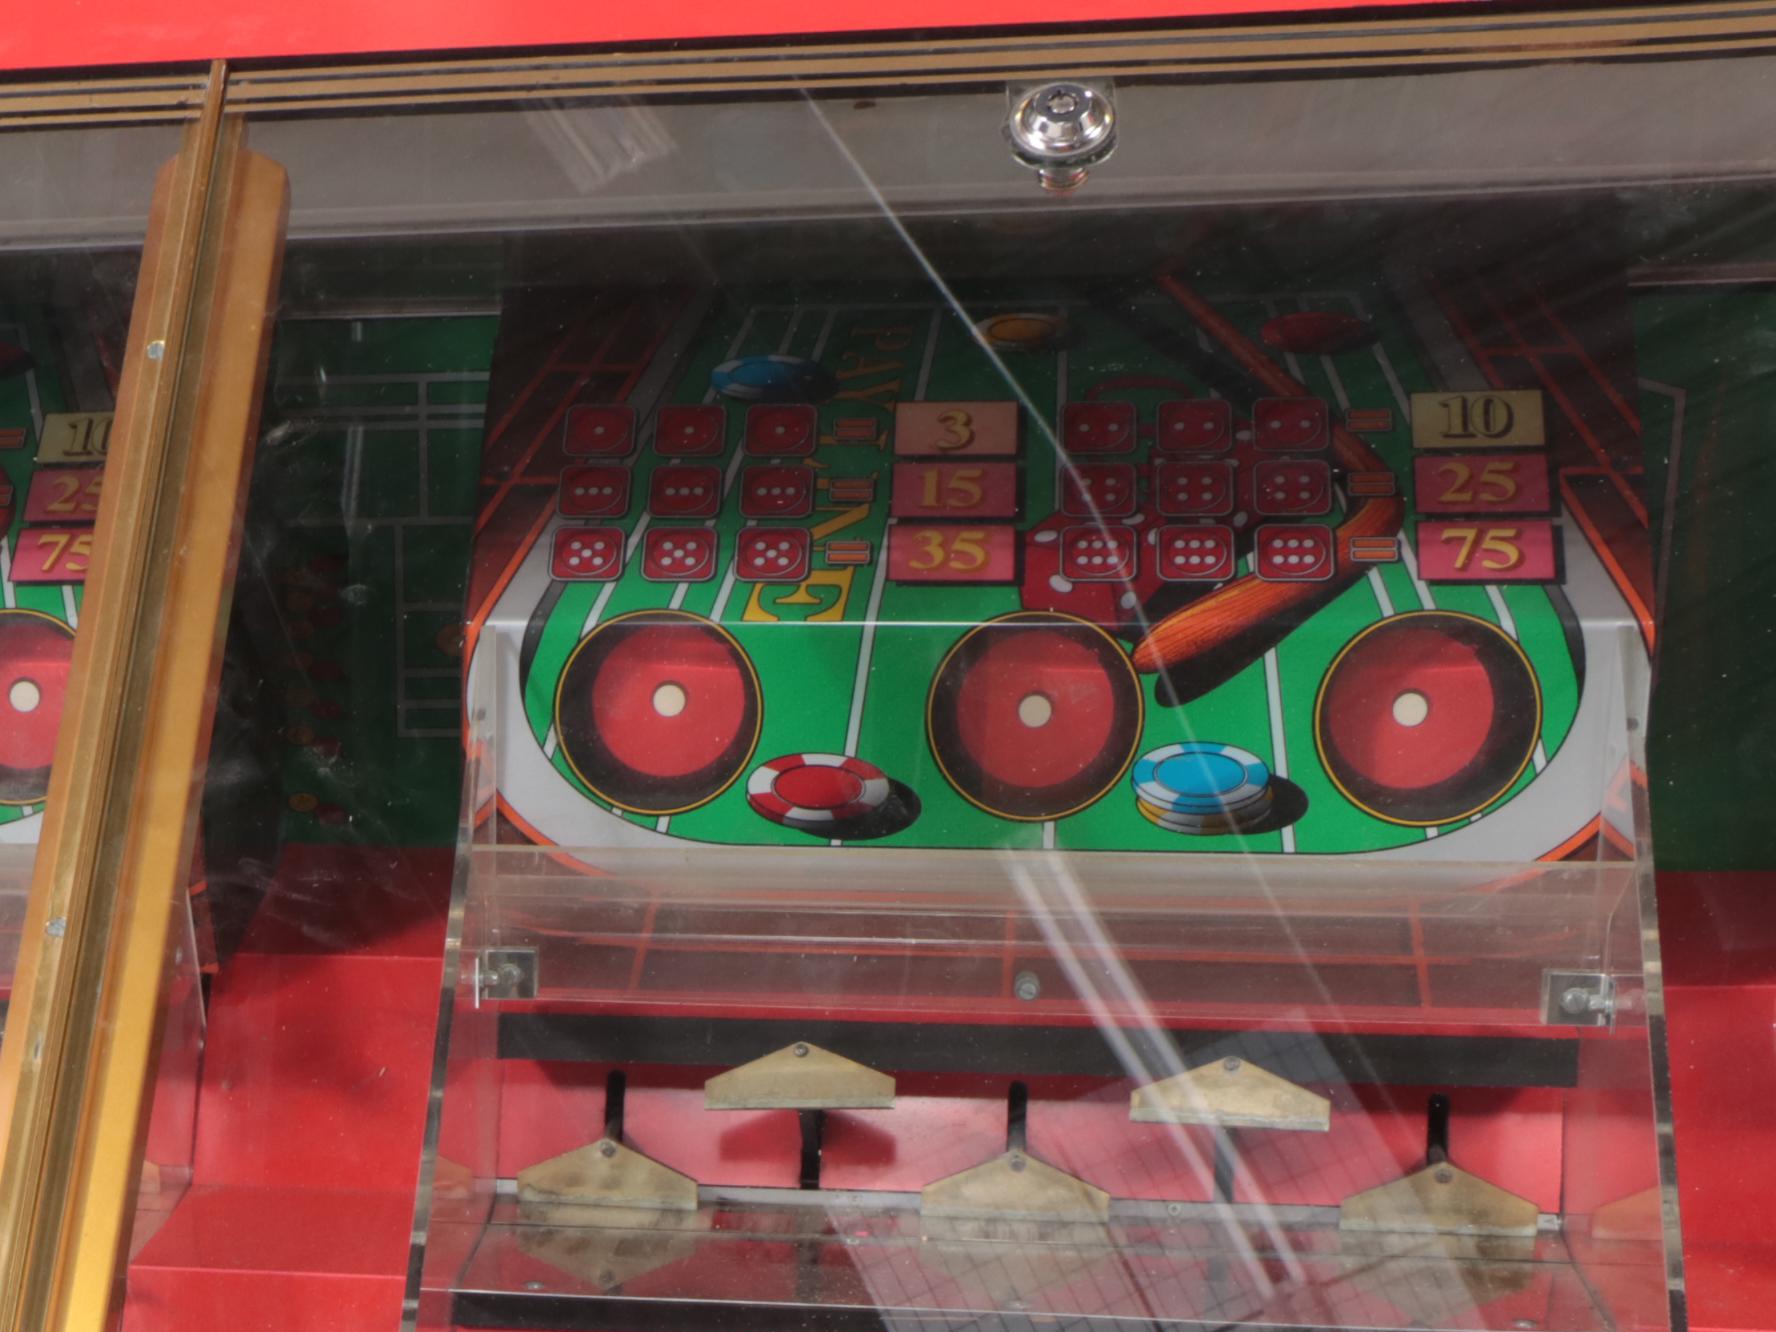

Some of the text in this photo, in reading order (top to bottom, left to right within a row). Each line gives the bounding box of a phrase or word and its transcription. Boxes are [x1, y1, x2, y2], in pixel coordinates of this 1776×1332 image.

[934, 409, 976, 452] 3
[1439, 394, 1515, 439] 10
[917, 466, 985, 508] 15
[1436, 461, 1518, 502] 25
[907, 528, 988, 572] 35
[1440, 527, 1523, 572] 75
